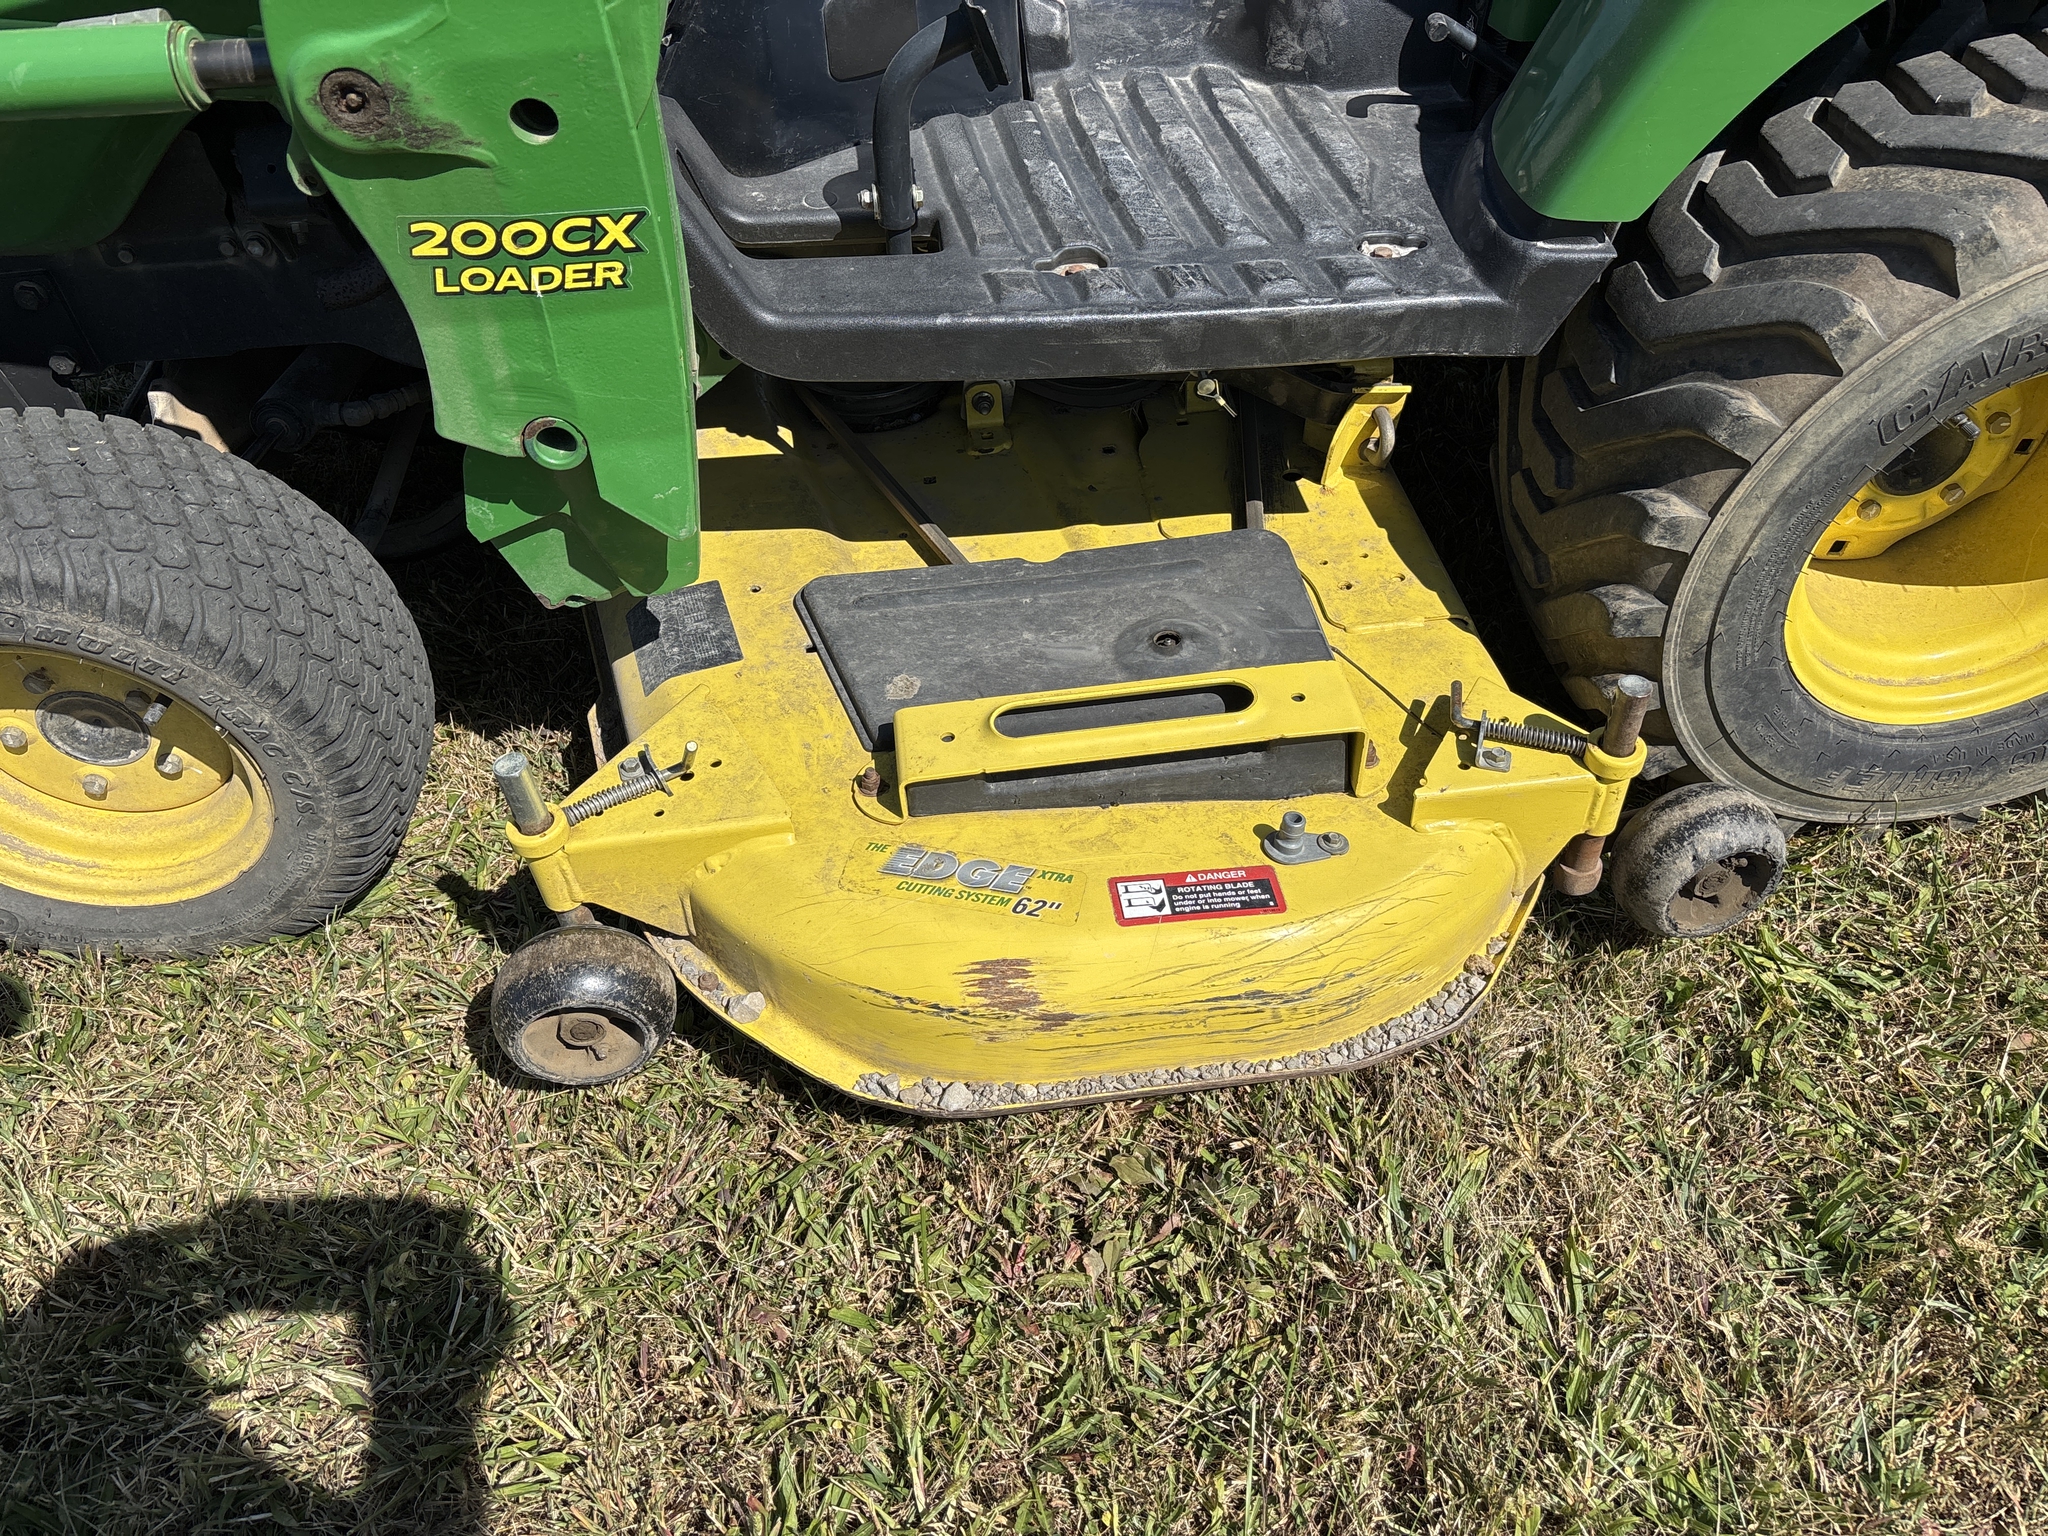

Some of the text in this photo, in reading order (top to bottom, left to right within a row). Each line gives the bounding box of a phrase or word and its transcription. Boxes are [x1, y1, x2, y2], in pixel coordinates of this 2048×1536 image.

[408, 211, 643, 258] 200CX
[433, 260, 628, 295] LOADER
[32, 624, 188, 685] MULTI
[199, 689, 289, 758] TRAC
[1976, 745, 1990, 757] IN
[1813, 766, 1973, 797] CHIEF
[299, 832, 319, 874] DANGER
[865, 842, 891, 853] THE
[877, 845, 1036, 894] EDGE
[1037, 870, 1074, 883] XTRA
[1197, 870, 1247, 881] DANGER
[1177, 881, 1255, 893] ROTATING BLADE
[1199, 892, 1212, 900] put
[896, 880, 1063, 918] CUTTING SYSTEM 62"
[1175, 904, 1201, 912] engine
[1211, 902, 1241, 910] running
